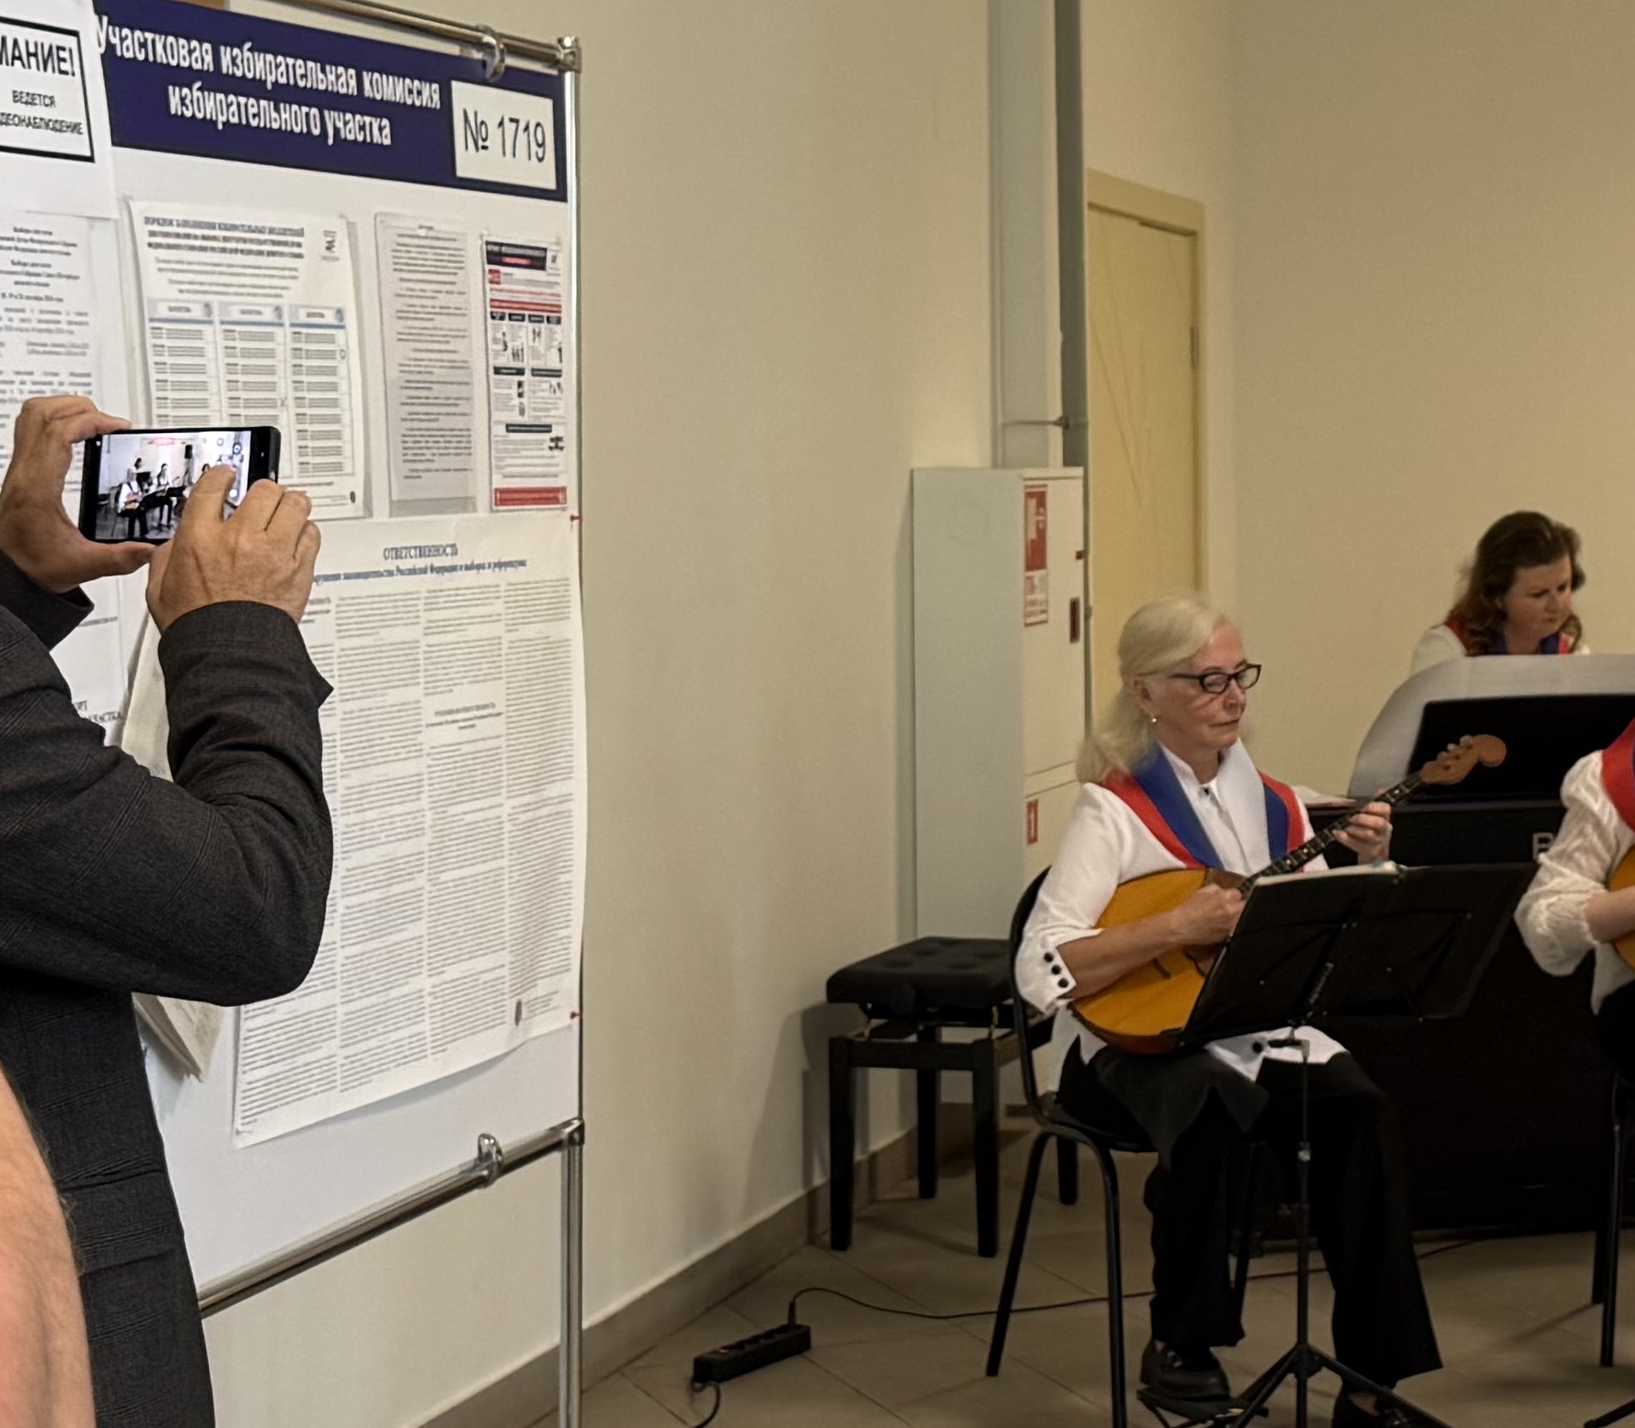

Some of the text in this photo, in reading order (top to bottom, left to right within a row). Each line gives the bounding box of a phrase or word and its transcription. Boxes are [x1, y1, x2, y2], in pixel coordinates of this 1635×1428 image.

[95, 15, 441, 110] Участковая избирательная комиссия
[168, 81, 392, 146] избирательного участка
[463, 108, 546, 163] № 1719
